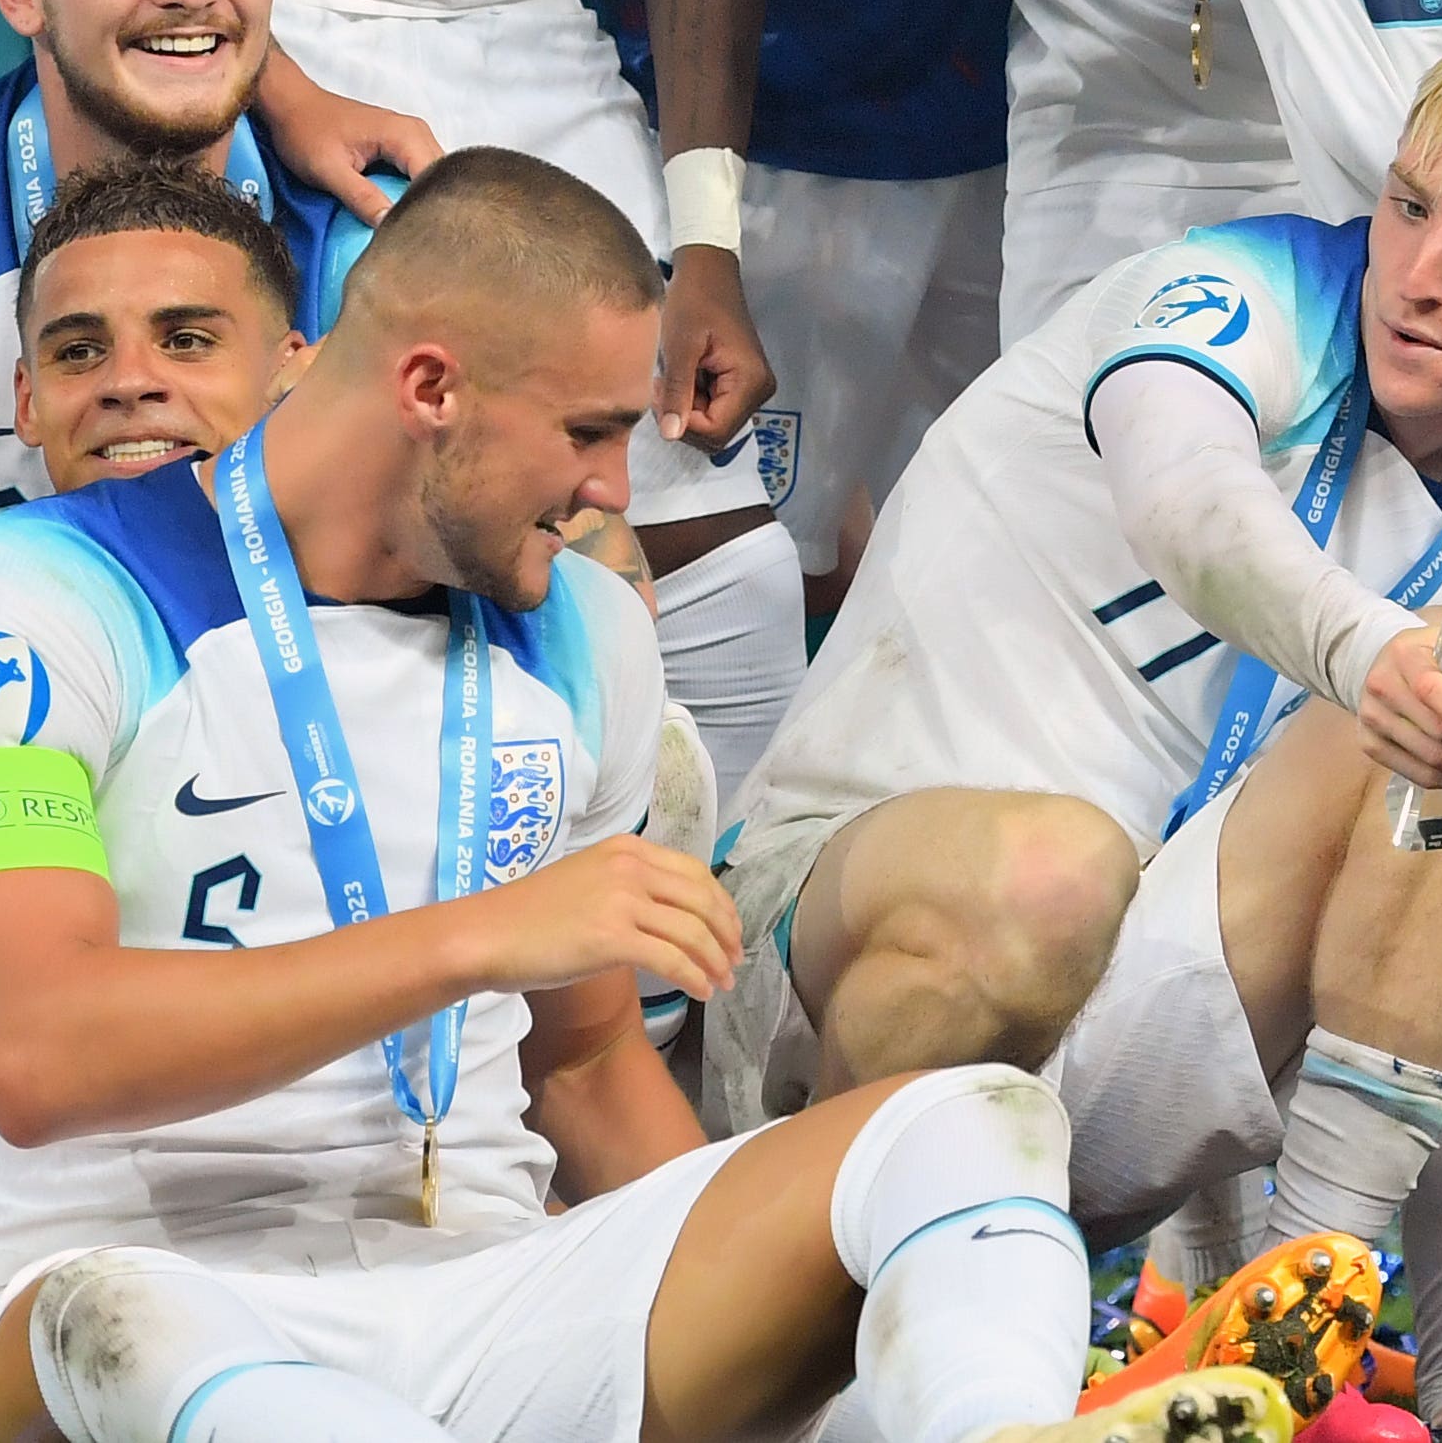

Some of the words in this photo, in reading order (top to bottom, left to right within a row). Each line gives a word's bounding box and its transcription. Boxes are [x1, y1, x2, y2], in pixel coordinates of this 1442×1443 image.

[17, 118, 39, 174] 2023
[230, 463, 269, 566] ROMANIA
[1308, 433, 1348, 524] GEORGIA
[260, 577, 303, 675] GEORGIA
[462, 624, 478, 719] GEORGIA
[1220, 711, 1251, 764] 2023
[458, 735, 476, 840] ROMANIA
[343, 880, 369, 924] 023
